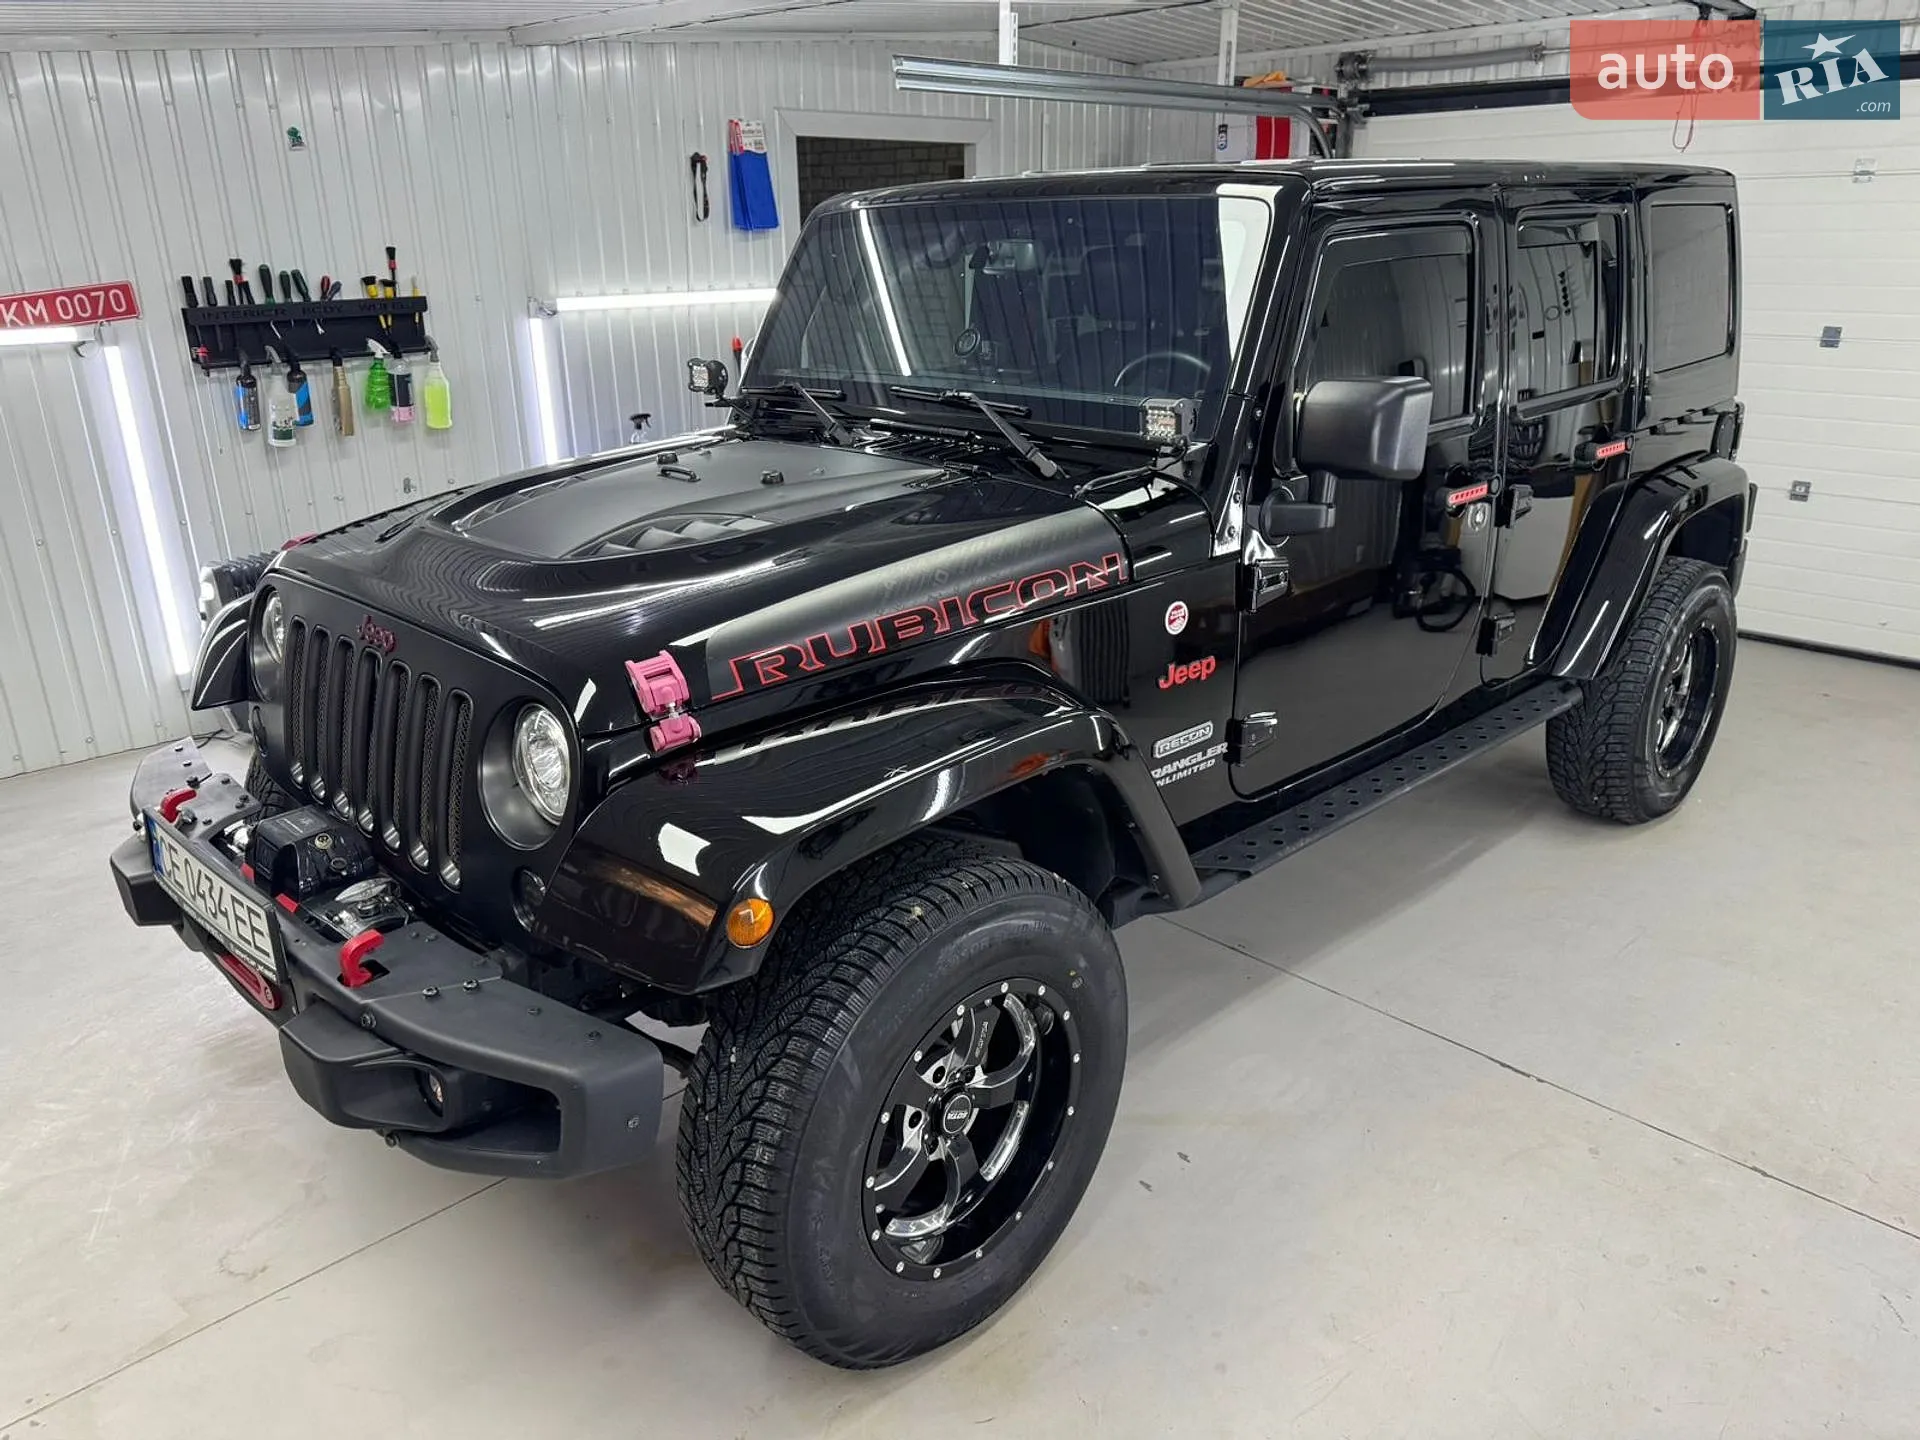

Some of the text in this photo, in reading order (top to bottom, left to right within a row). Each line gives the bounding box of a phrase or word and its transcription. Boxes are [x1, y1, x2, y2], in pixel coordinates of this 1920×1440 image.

[0, 289, 127, 327] KM 0070
[711, 553, 1129, 701] RUBICON
[1158, 655, 1216, 688] Jeep
[1160, 726, 1210, 754] RECON
[184, 857, 231, 935] 0434
[231, 894, 271, 958] EE
